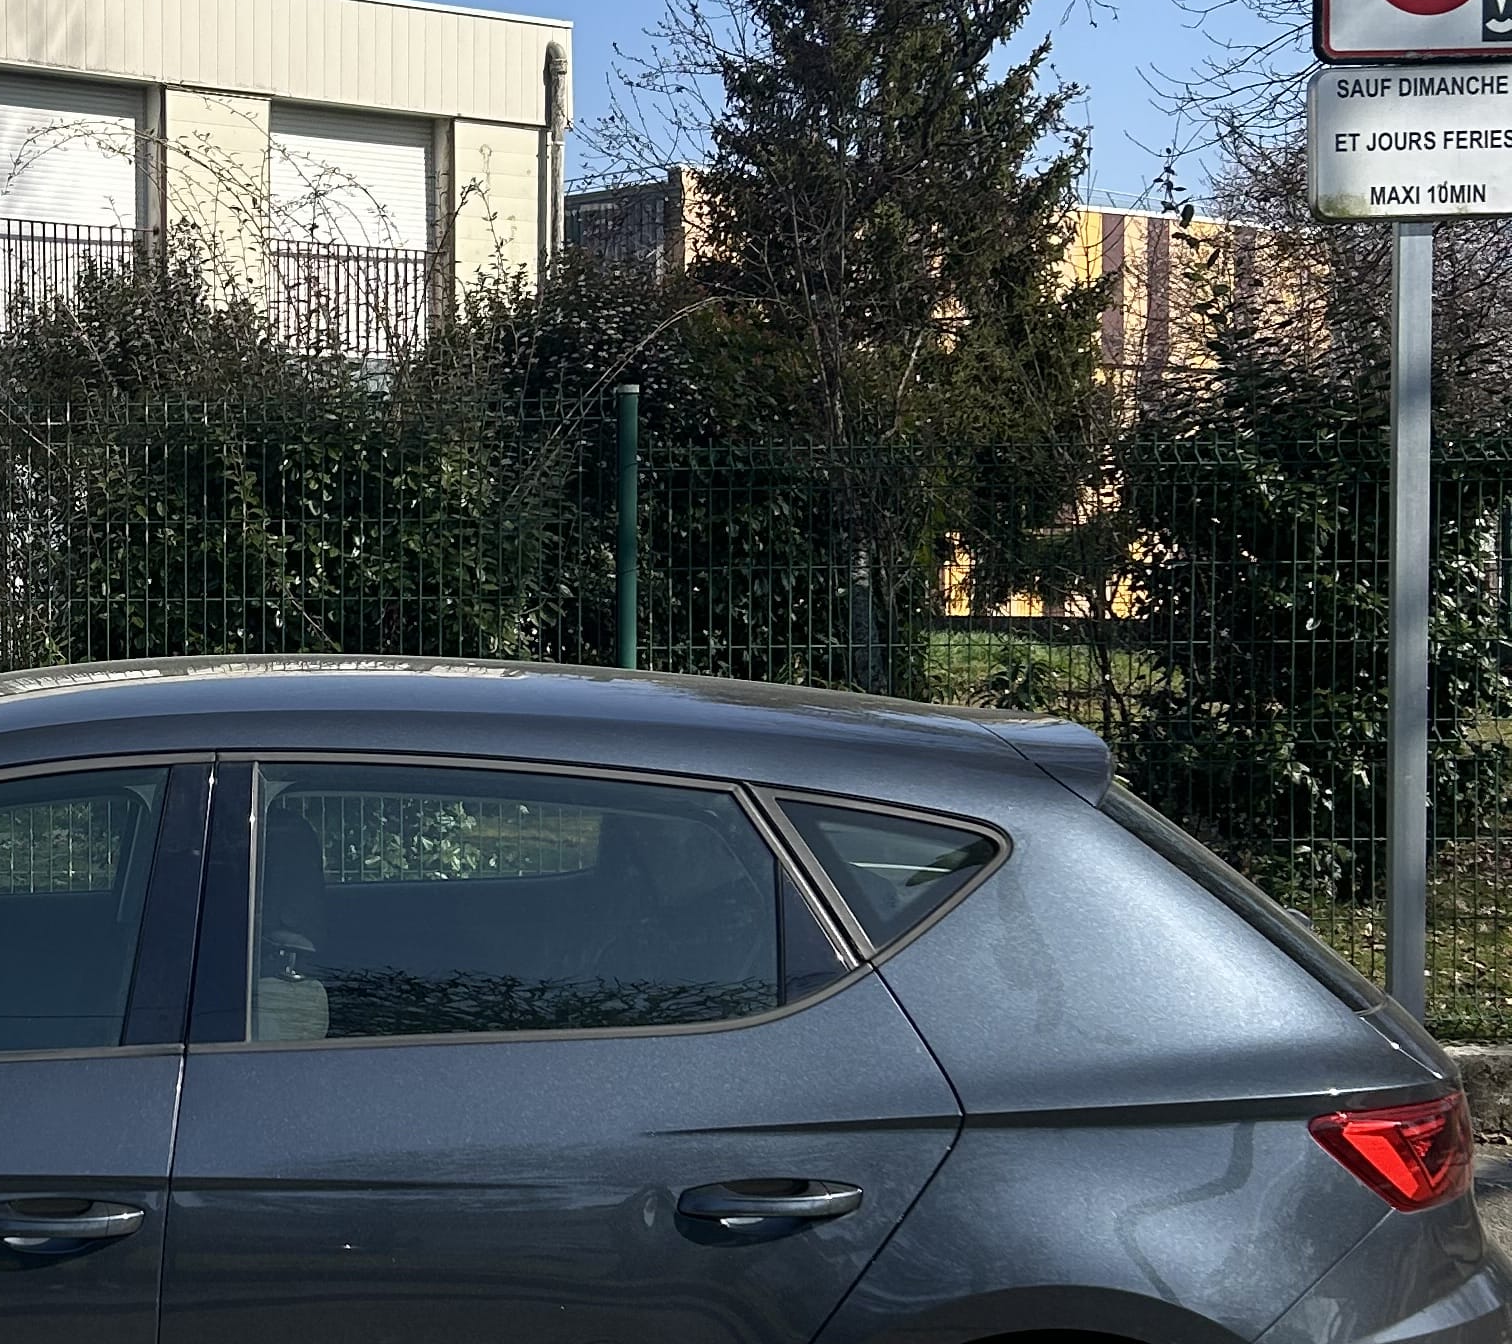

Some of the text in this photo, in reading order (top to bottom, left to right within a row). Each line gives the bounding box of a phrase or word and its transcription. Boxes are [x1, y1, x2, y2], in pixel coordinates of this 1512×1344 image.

[1337, 75, 1509, 98] SAUF DIMANCHE
[1335, 129, 1512, 152] ET JOURS FERIES
[1370, 186, 1420, 205] MAXI
